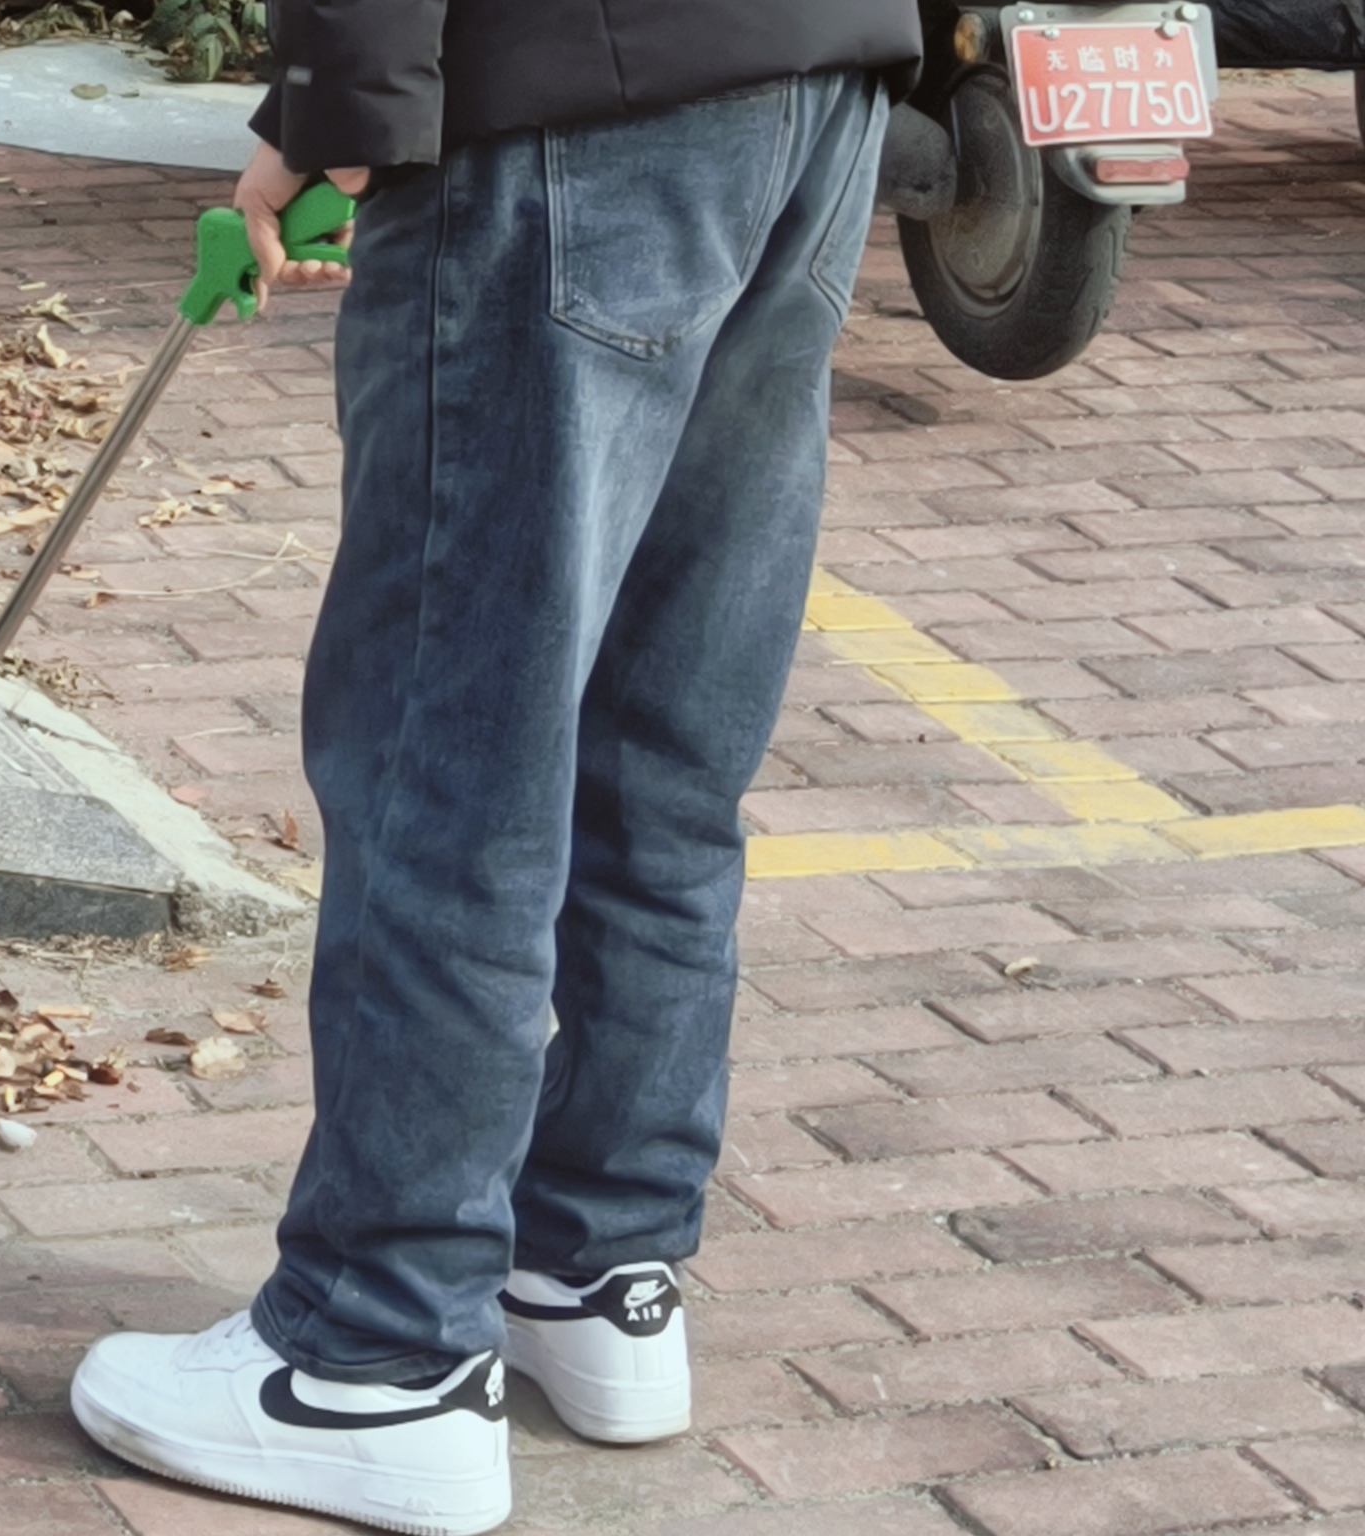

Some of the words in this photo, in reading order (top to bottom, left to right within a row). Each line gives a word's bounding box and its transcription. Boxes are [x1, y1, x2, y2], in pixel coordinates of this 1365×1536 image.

[1046, 45, 1174, 74] 无临时为
[1028, 80, 1202, 133] U27750
[626, 1303, 662, 1322] AIR
